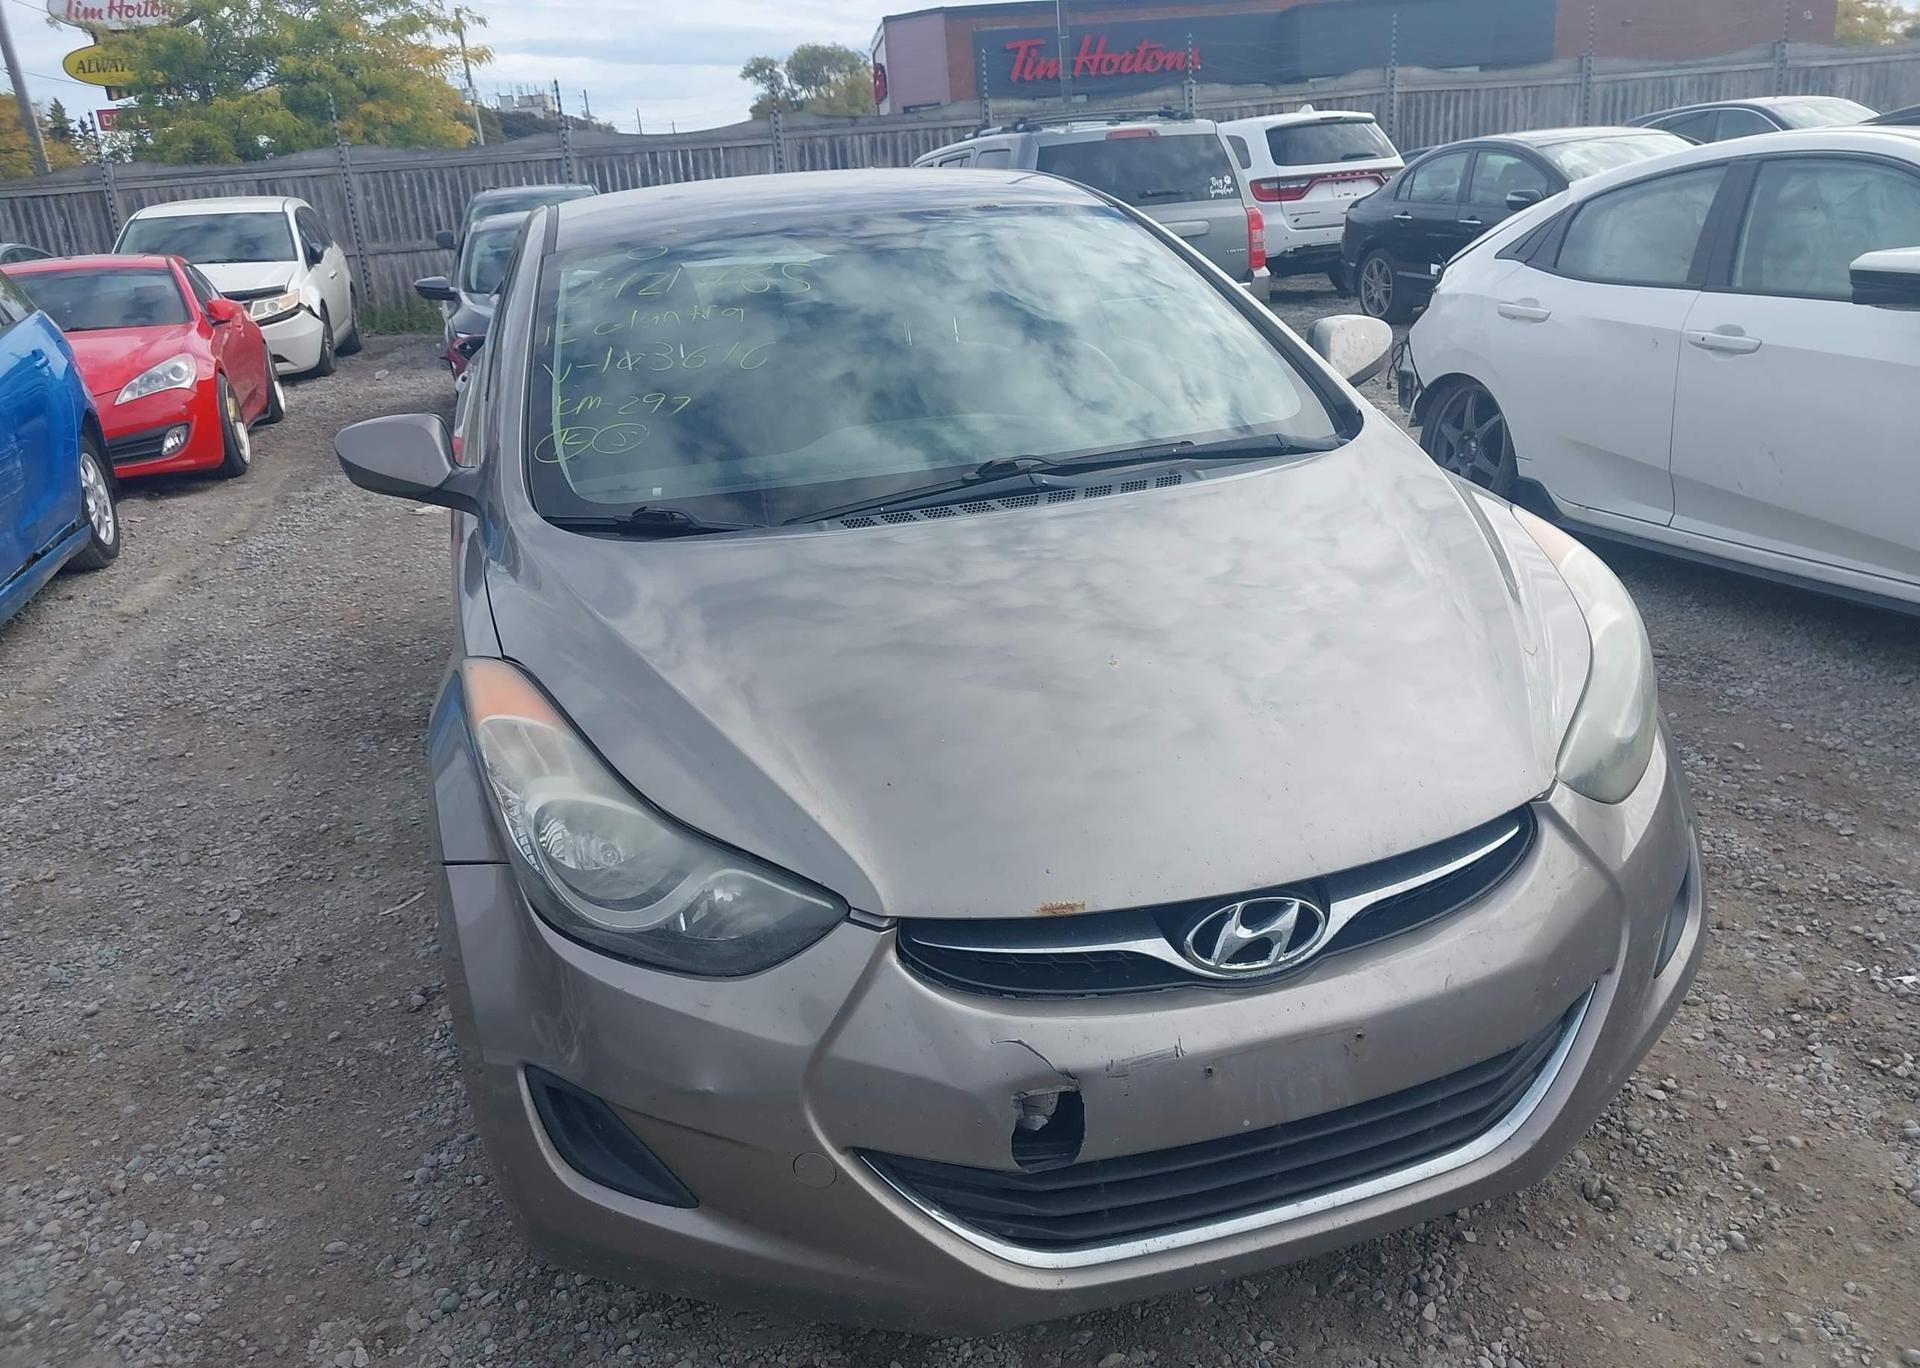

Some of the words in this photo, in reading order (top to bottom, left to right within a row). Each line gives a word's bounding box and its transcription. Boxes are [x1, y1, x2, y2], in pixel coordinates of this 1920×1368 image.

[107, 0, 174, 19] Horton
[76, 58, 135, 74] ALWAY
[1005, 38, 1063, 81] Tim
[1073, 34, 1203, 78] Hortons
